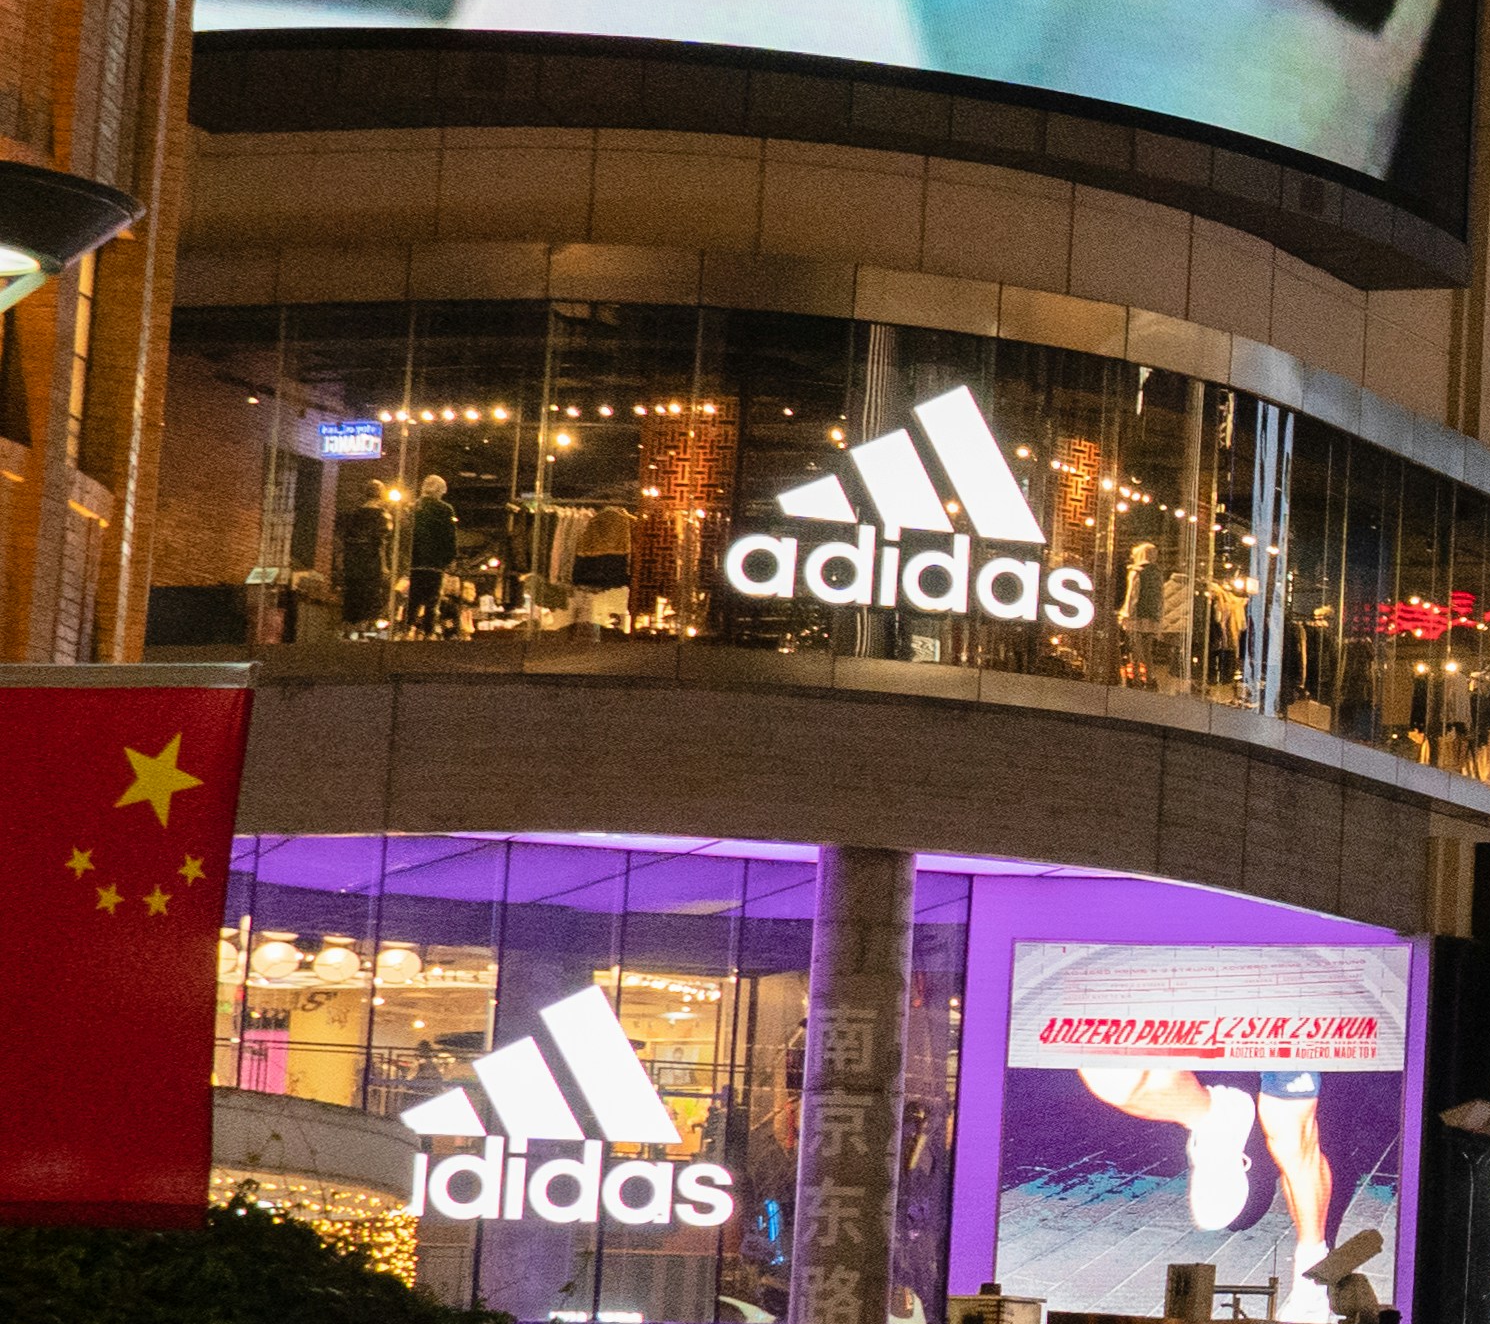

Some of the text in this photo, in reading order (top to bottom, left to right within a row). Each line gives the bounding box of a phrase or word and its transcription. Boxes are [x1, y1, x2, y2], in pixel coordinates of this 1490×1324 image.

[724, 522, 1096, 632] adidas
[1135, 1018, 1206, 1045] PRIME
[408, 1137, 734, 1228] didas
